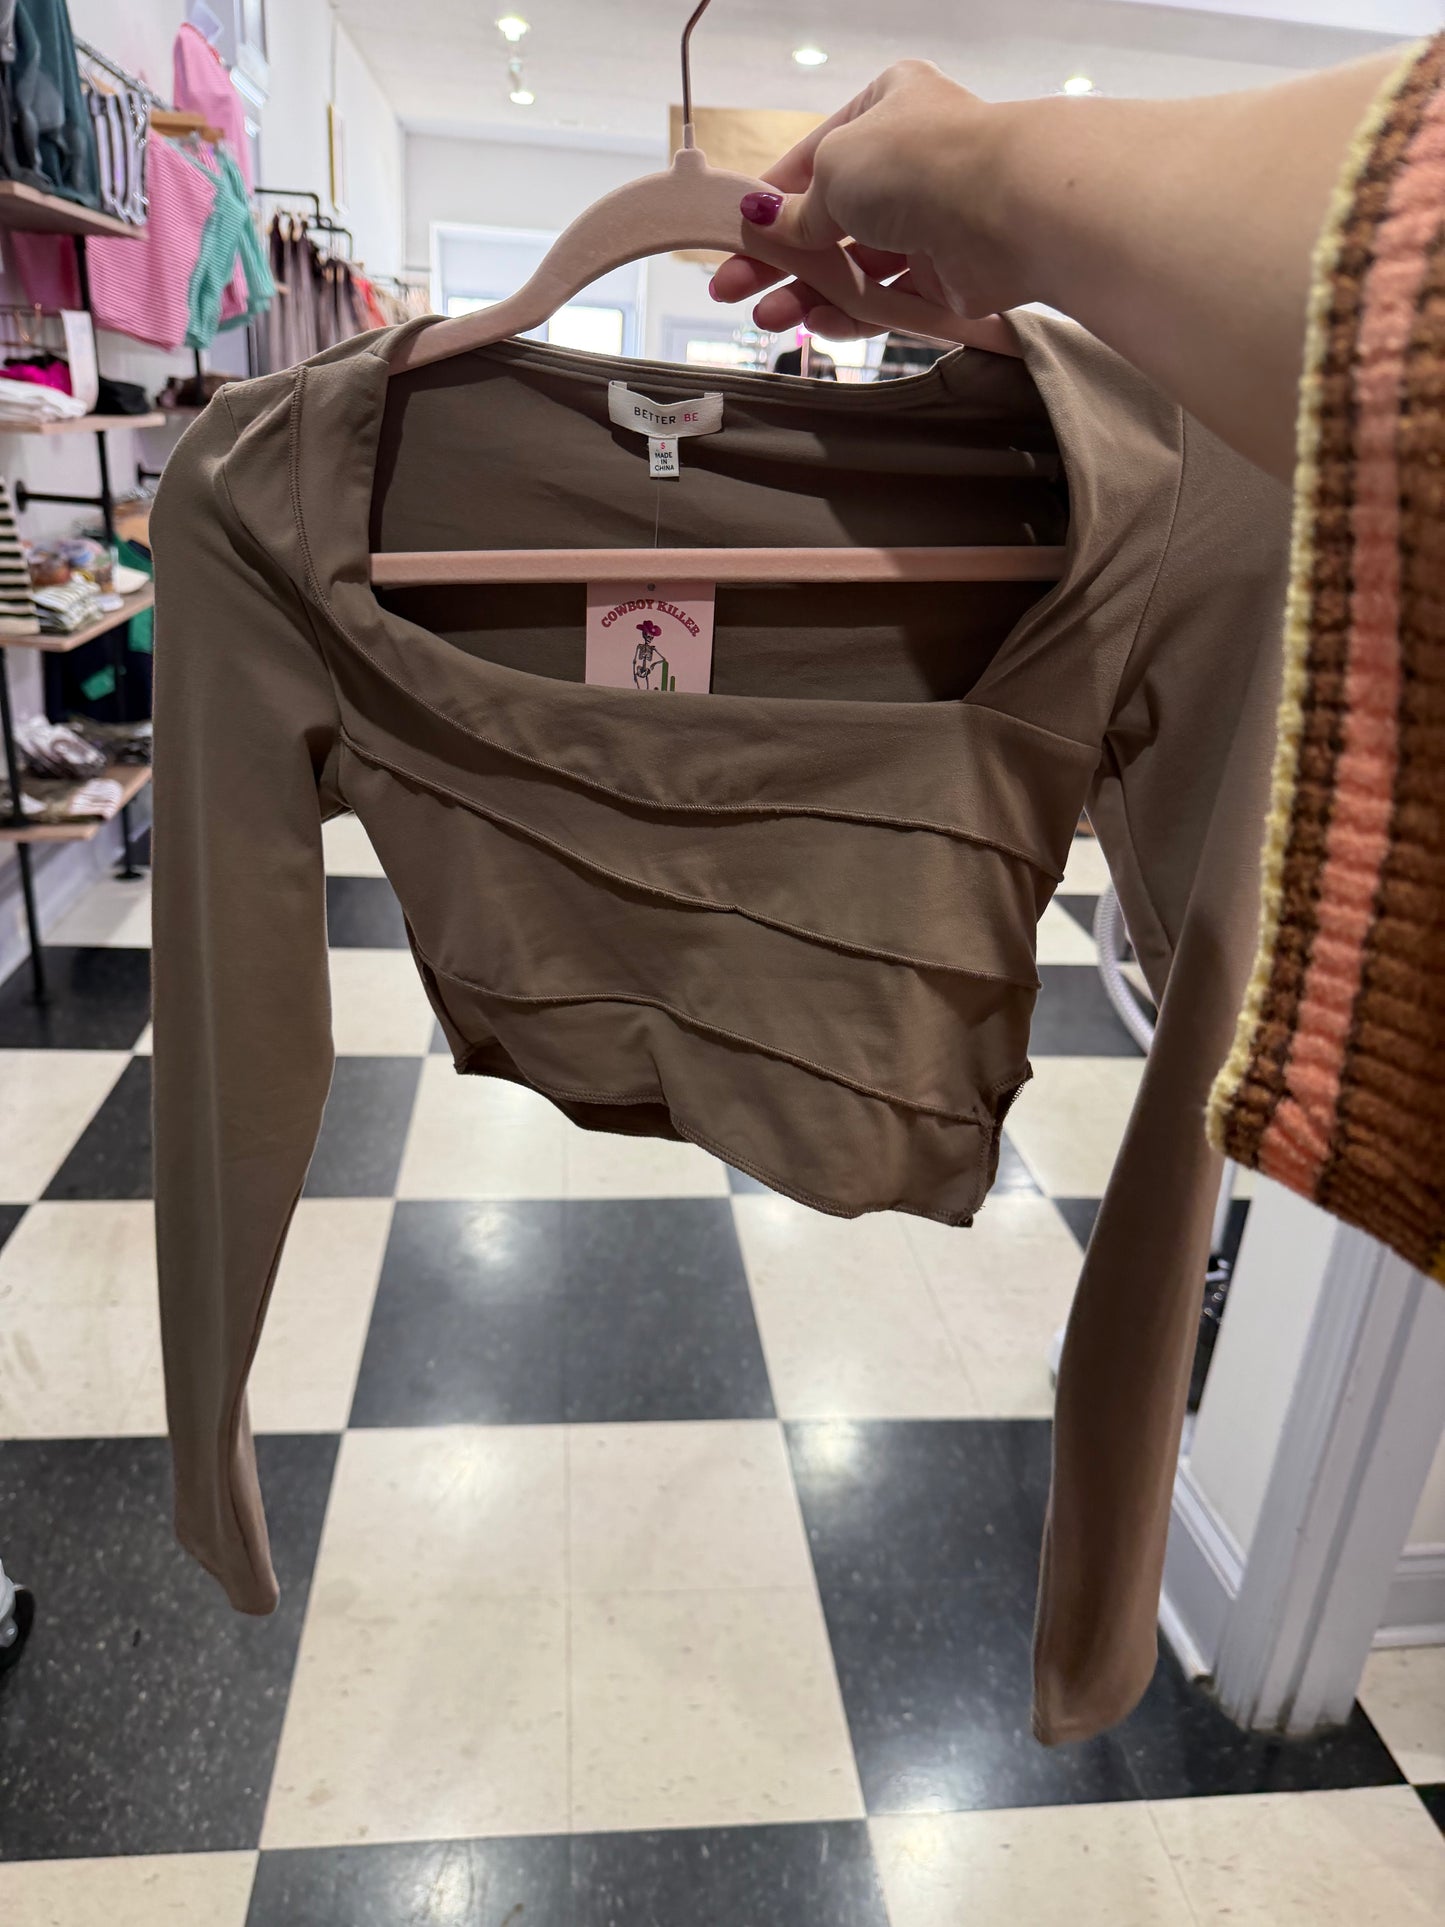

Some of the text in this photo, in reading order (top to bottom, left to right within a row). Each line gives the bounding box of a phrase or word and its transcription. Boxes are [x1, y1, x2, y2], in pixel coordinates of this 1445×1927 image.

[634, 406, 699, 425] BETTER BE
[601, 599, 701, 637] COWBOY KILLER
